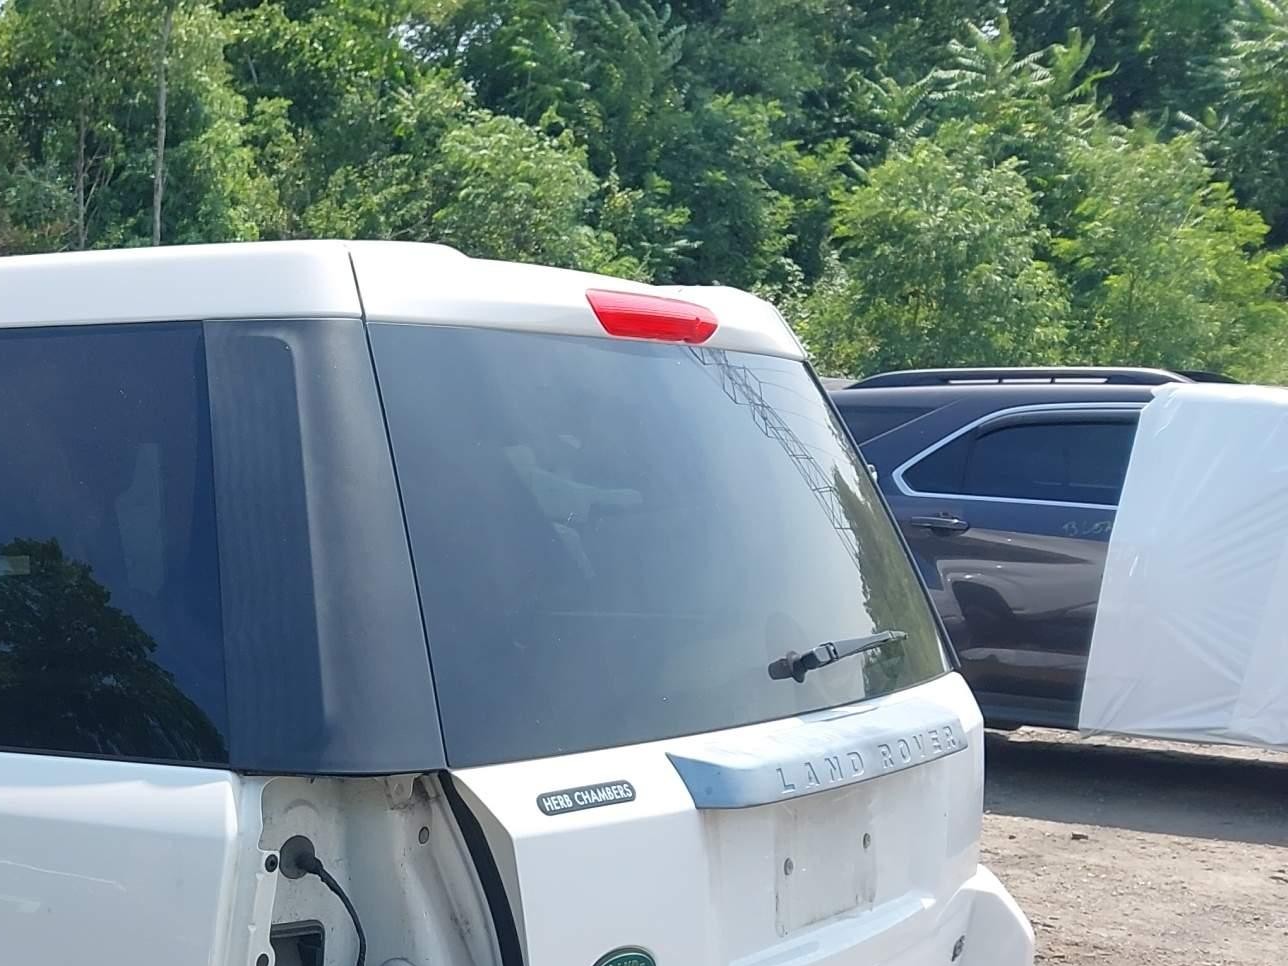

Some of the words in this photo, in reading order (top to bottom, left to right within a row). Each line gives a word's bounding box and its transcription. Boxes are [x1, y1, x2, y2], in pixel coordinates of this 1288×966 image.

[776, 751, 865, 794] LAND
[878, 725, 957, 769] ROVER
[542, 794, 573, 812] HERB
[574, 783, 633, 806] CHAMBERS
